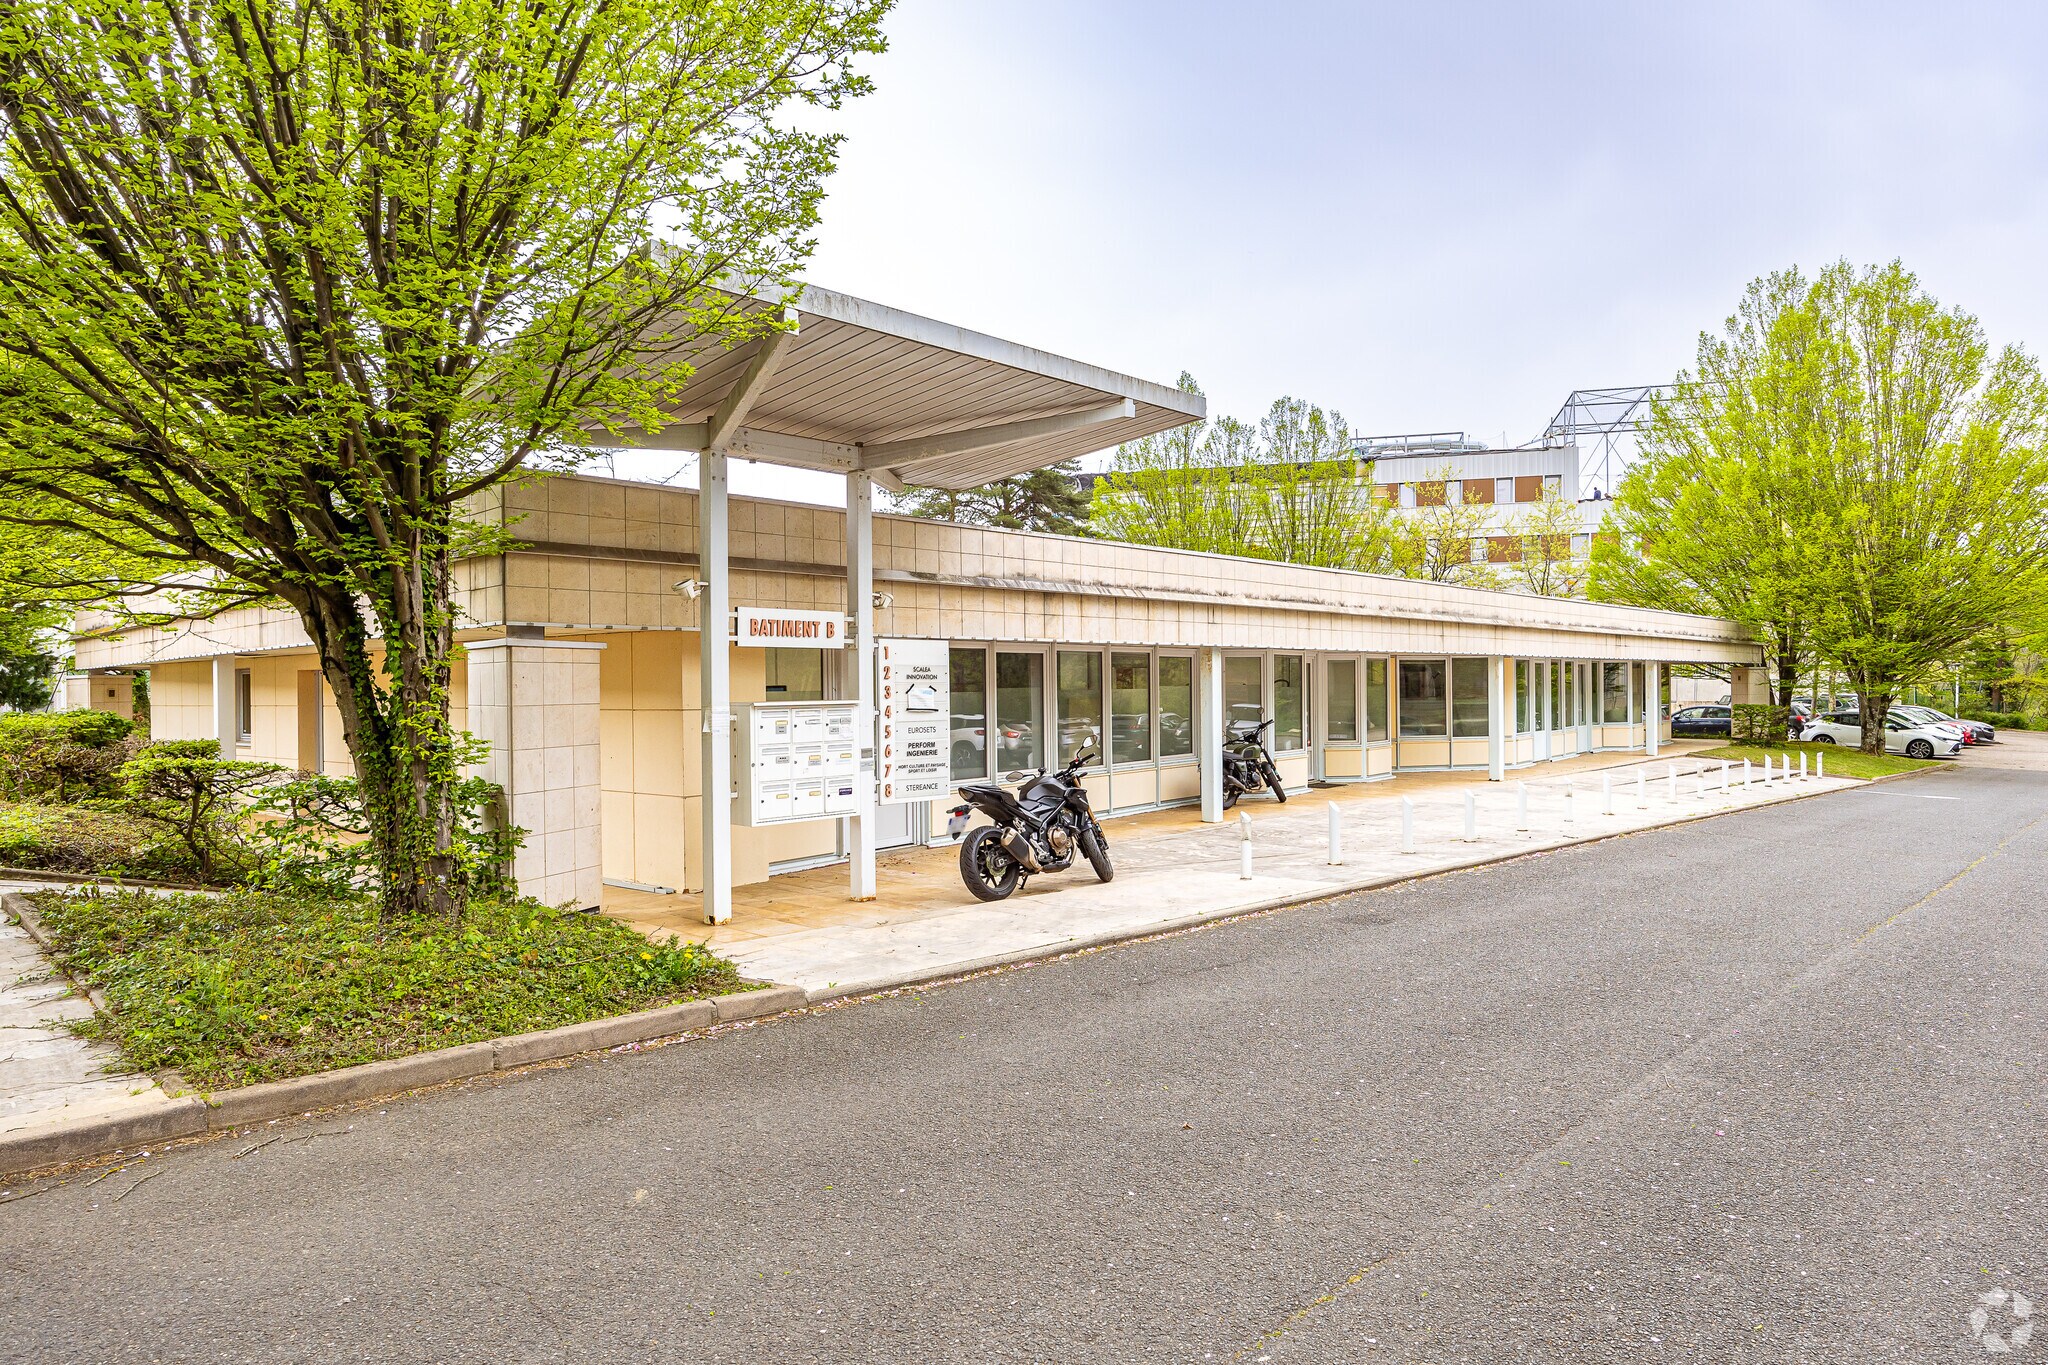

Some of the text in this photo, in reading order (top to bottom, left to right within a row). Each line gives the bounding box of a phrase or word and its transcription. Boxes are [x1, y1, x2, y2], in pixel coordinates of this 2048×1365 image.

[750, 618, 835, 638] BATIMENT B
[884, 646, 889, 660] 1
[883, 665, 891, 680] 2
[885, 685, 892, 699] 3
[885, 705, 892, 719] 4
[885, 725, 892, 739] 5
[908, 726, 936, 734] EUROSETS
[885, 744, 892, 758] 6
[906, 749, 938, 757] INGENIERIE
[885, 764, 892, 778] 7
[885, 784, 892, 797] 8
[906, 783, 938, 791] STEREANCE
